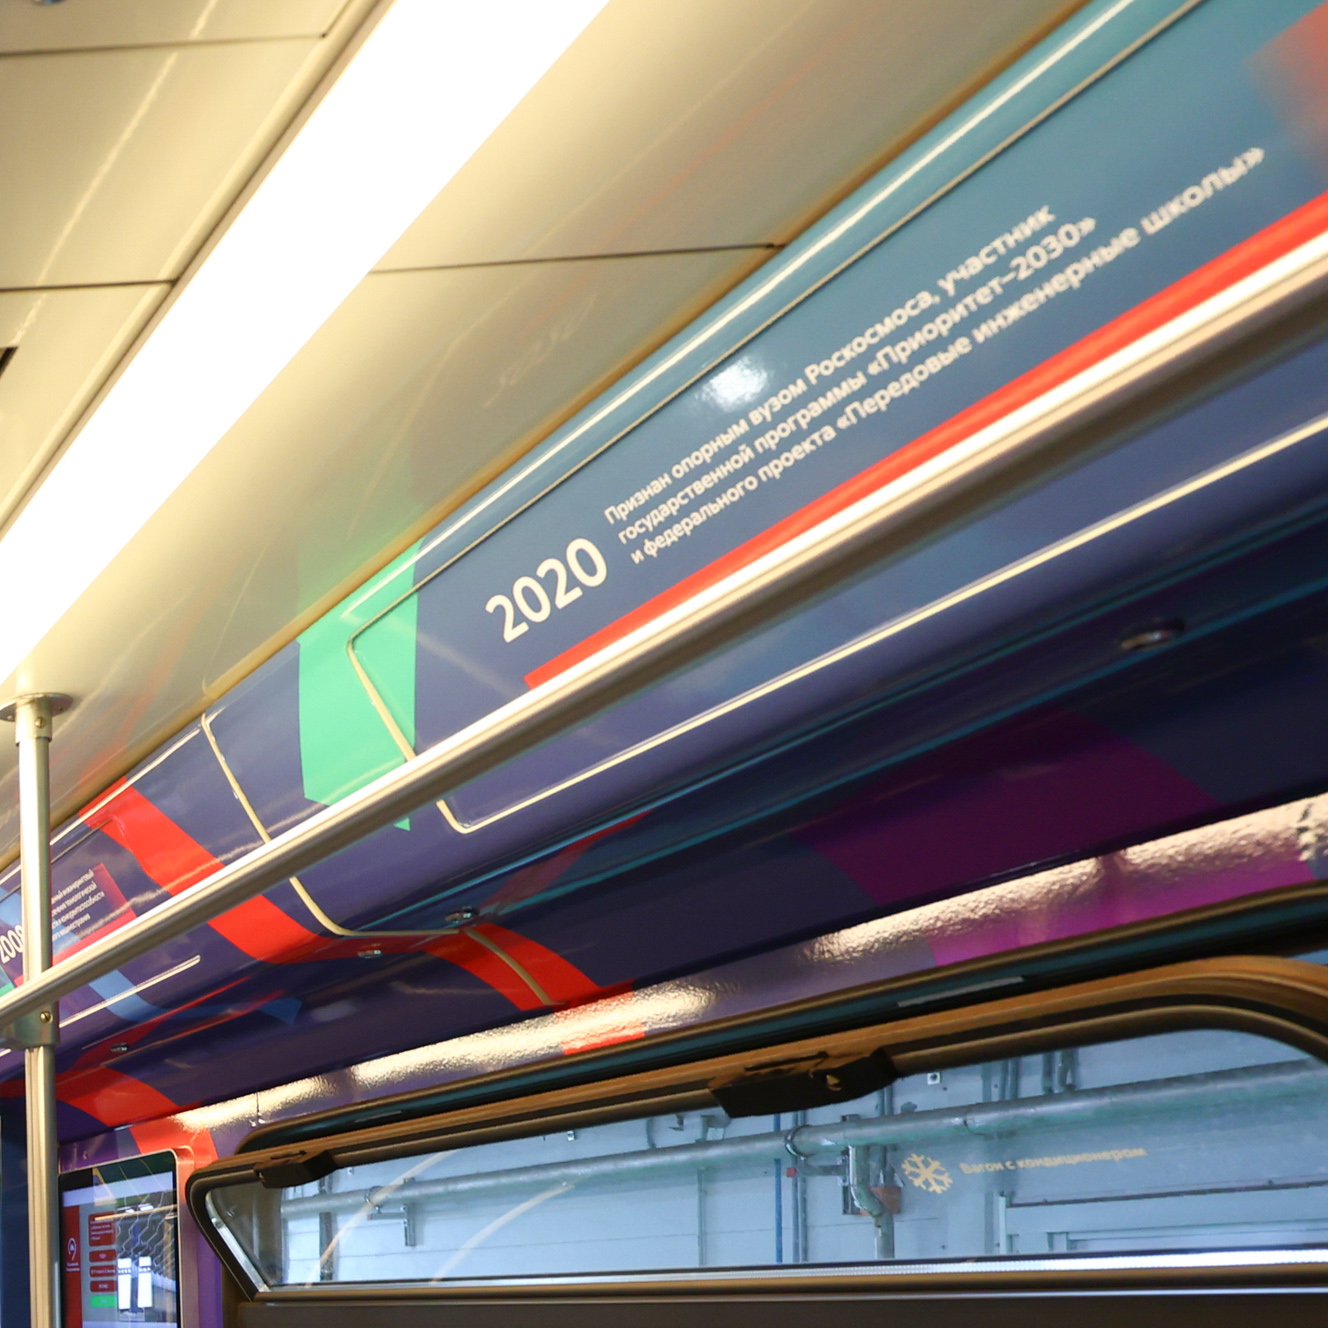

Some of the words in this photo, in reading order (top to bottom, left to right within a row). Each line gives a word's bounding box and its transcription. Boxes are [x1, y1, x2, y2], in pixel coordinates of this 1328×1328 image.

[604, 473, 671, 525] Признан
[671, 422, 750, 483] опорным
[748, 385, 808, 434] вузом
[804, 293, 941, 385] Роскосмоса,
[940, 205, 1055, 304] участник
[630, 549, 644, 564] и
[642, 476, 758, 560] федерального
[757, 430, 836, 489] проекта
[834, 335, 973, 434] «Передовые
[973, 226, 1142, 342] инженерные
[1140, 146, 1265, 237] школы»
[618, 445, 755, 544] государственной
[753, 374, 867, 462] программы
[486, 536, 609, 643] 2020
[960, 1162, 1004, 1174] Вагон
[1005, 1160, 1016, 1170] с
[1016, 1148, 1148, 1168] кондиционером
